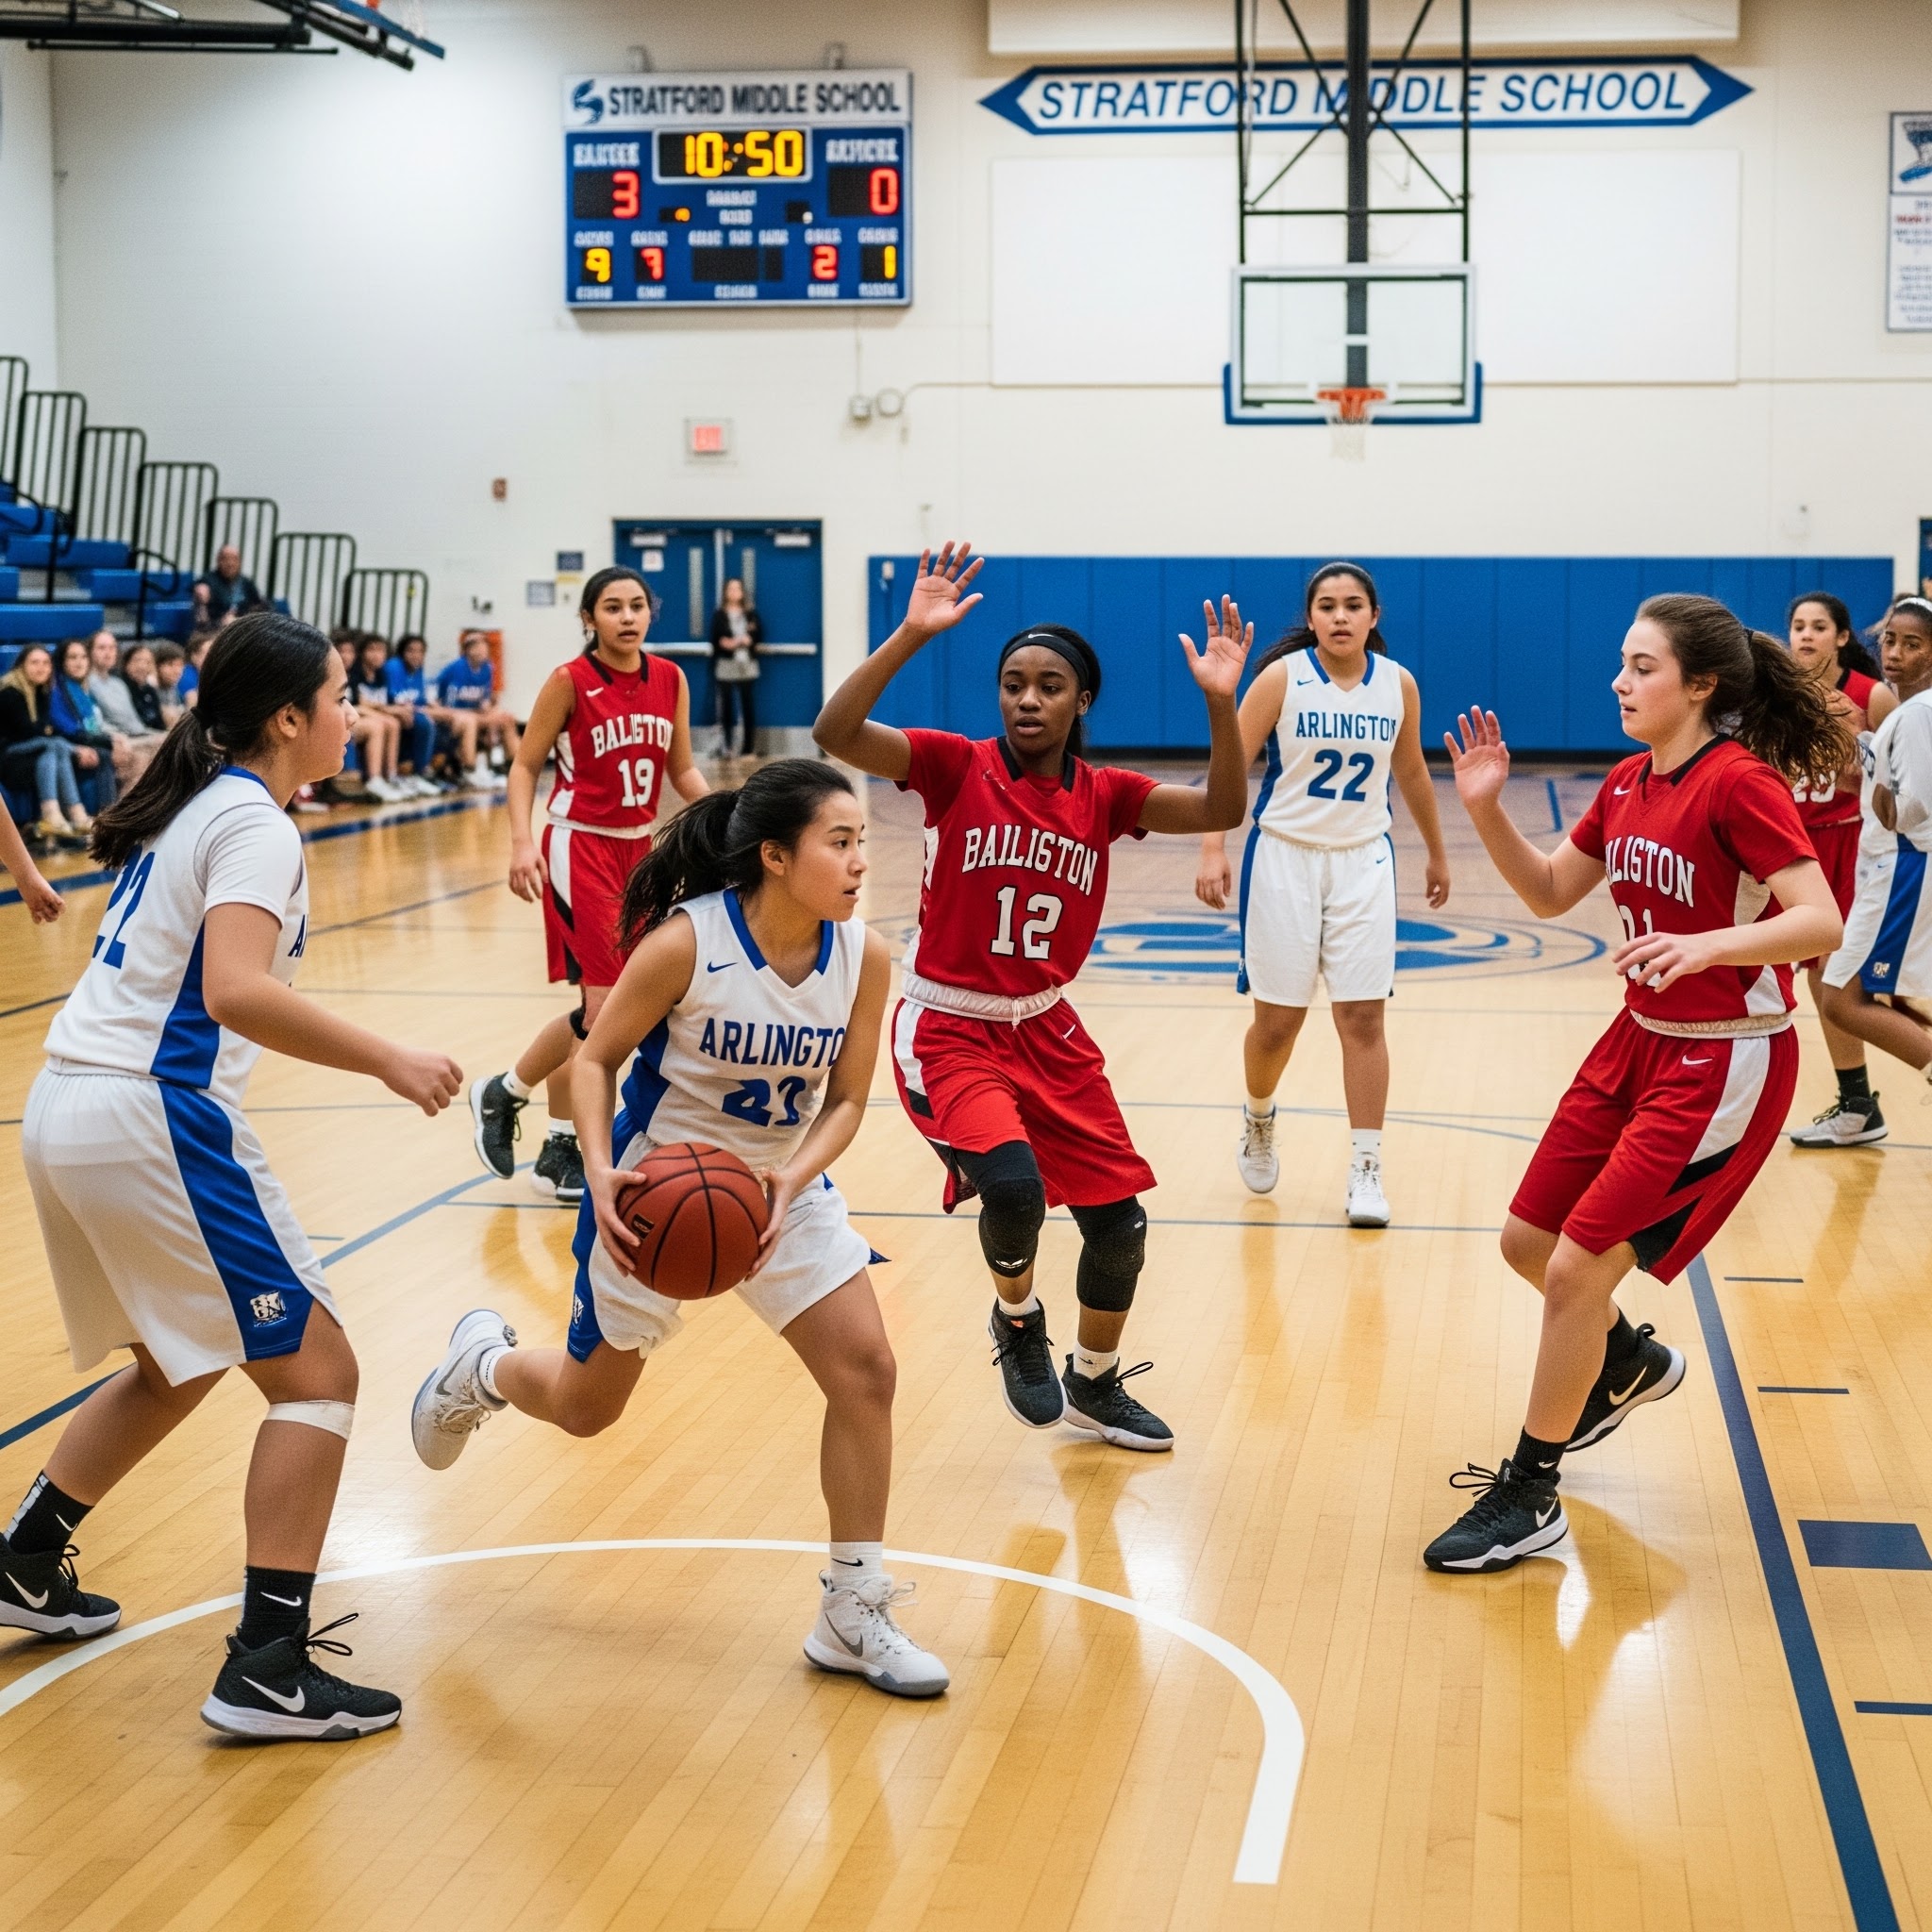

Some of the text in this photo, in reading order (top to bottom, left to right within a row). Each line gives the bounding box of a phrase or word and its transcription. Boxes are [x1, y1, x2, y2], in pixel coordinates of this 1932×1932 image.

[608, 81, 901, 116] STRATFORD MIDDLE SCHOOL
[1039, 71, 1685, 119] STRATFORD MDDLE SCHOOL
[612, 171, 640, 219] 3
[869, 168, 898, 216] 0
[585, 247, 611, 283] 9
[812, 245, 839, 280] 2
[883, 245, 897, 280] 1
[1295, 711, 1397, 743] ARLINGTON
[618, 758, 655, 807] 19
[1307, 748, 1374, 802] 22
[991, 886, 1063, 959] 12
[699, 1017, 845, 1068] ARLINGTO
